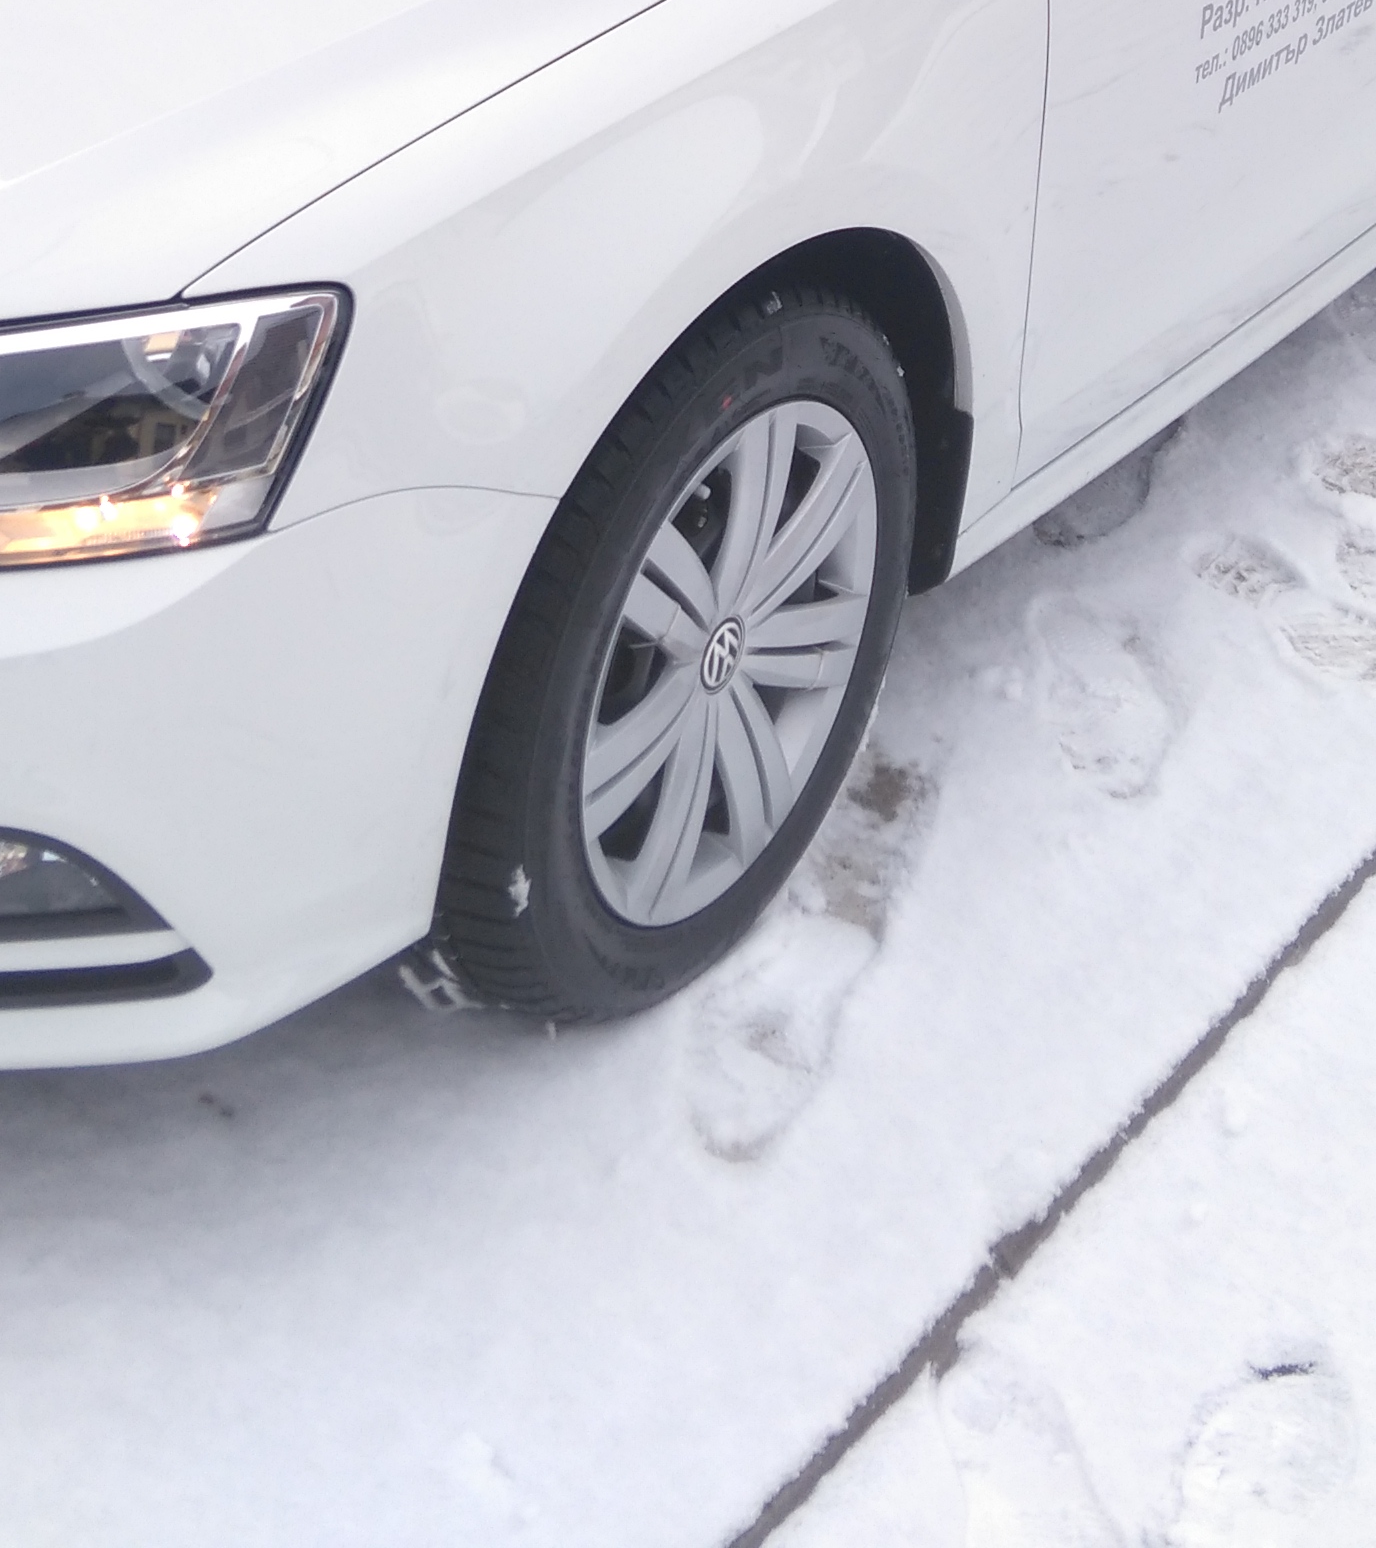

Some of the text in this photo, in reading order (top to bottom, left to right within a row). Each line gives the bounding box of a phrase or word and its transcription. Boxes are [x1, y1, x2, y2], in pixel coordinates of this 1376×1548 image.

[1194, 48, 1228, 84] тел.:
[1231, 20, 1264, 62] 0896
[1266, 4, 1290, 40] 333
[1218, 32, 1308, 114] Димитър
